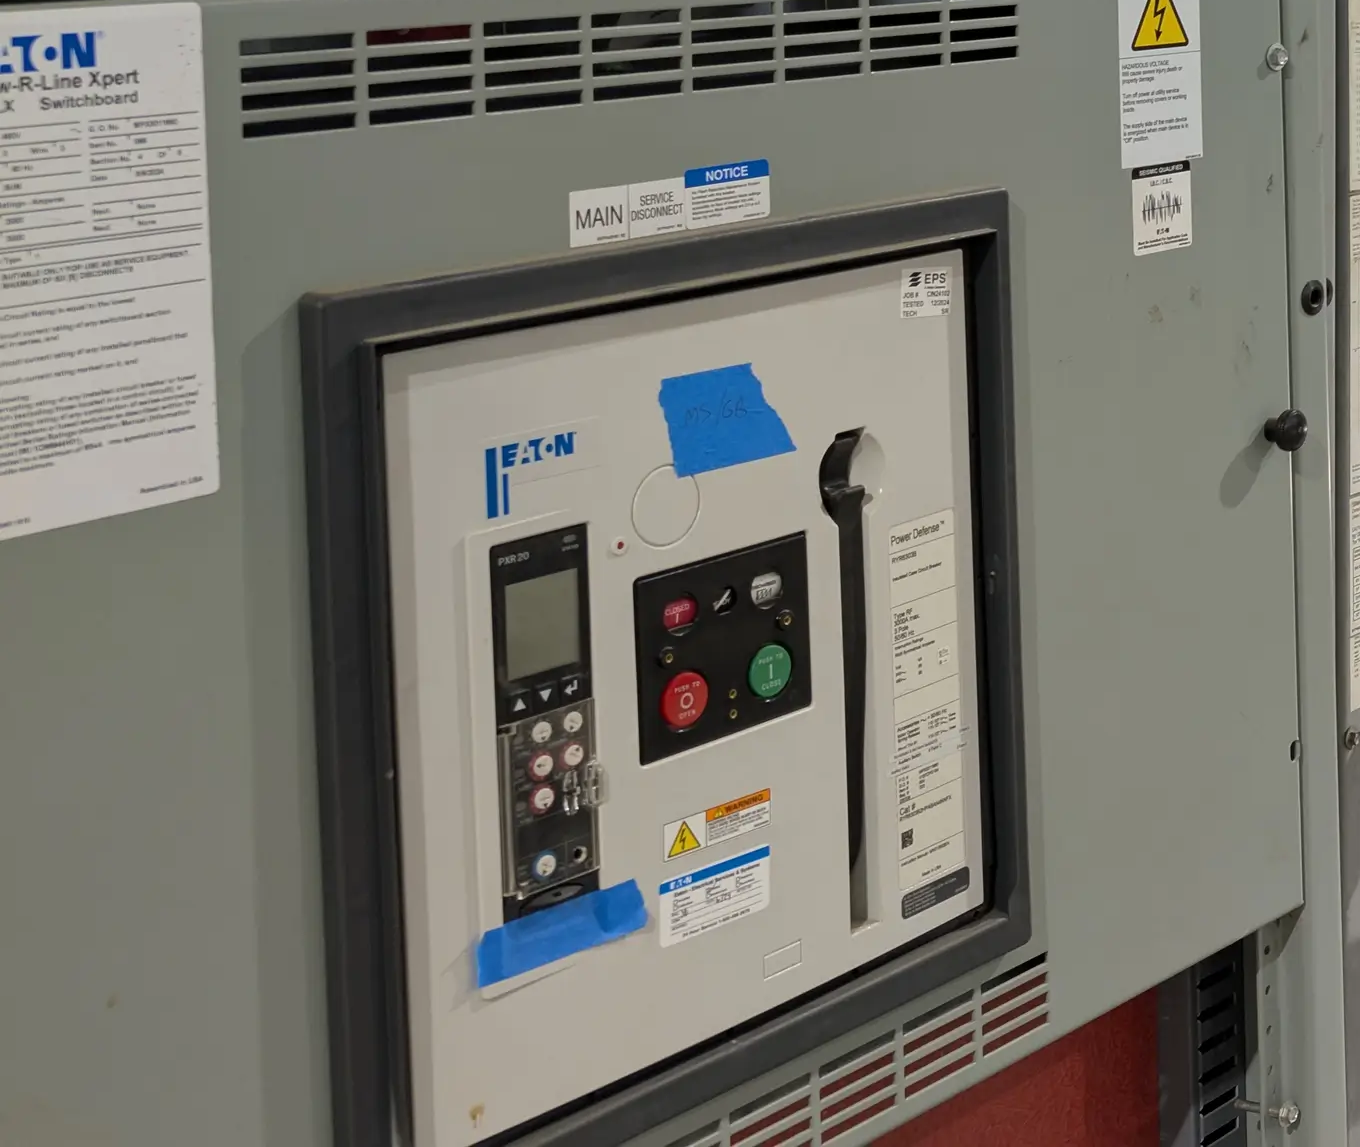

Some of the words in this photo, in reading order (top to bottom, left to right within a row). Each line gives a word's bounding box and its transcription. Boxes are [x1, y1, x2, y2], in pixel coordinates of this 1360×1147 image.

[1122, 61, 1149, 70] HAZARDOUS
[1149, 60, 1170, 68] VOLTAGE
[88, 69, 140, 88] Xpert
[39, 91, 140, 111] Switchboard
[705, 165, 749, 183] NOTICE
[1159, 163, 1184, 174] QUALIFIED
[639, 191, 675, 207] SERVICE
[575, 204, 624, 230] MAIN
[630, 203, 684, 222] DISCONNECT
[924, 272, 947, 285] EPS
[500, 431, 577, 469] EATON
[890, 533, 912, 547] Power
[912, 523, 940, 540] Defense
[497, 553, 517, 567] PXR
[517, 551, 530, 563] 20
[664, 603, 690, 616] CLOSED
[691, 680, 701, 689] TO
[761, 678, 782, 691] CLOSE
[724, 793, 764, 814] WARNING
[899, 805, 910, 815] Cat
